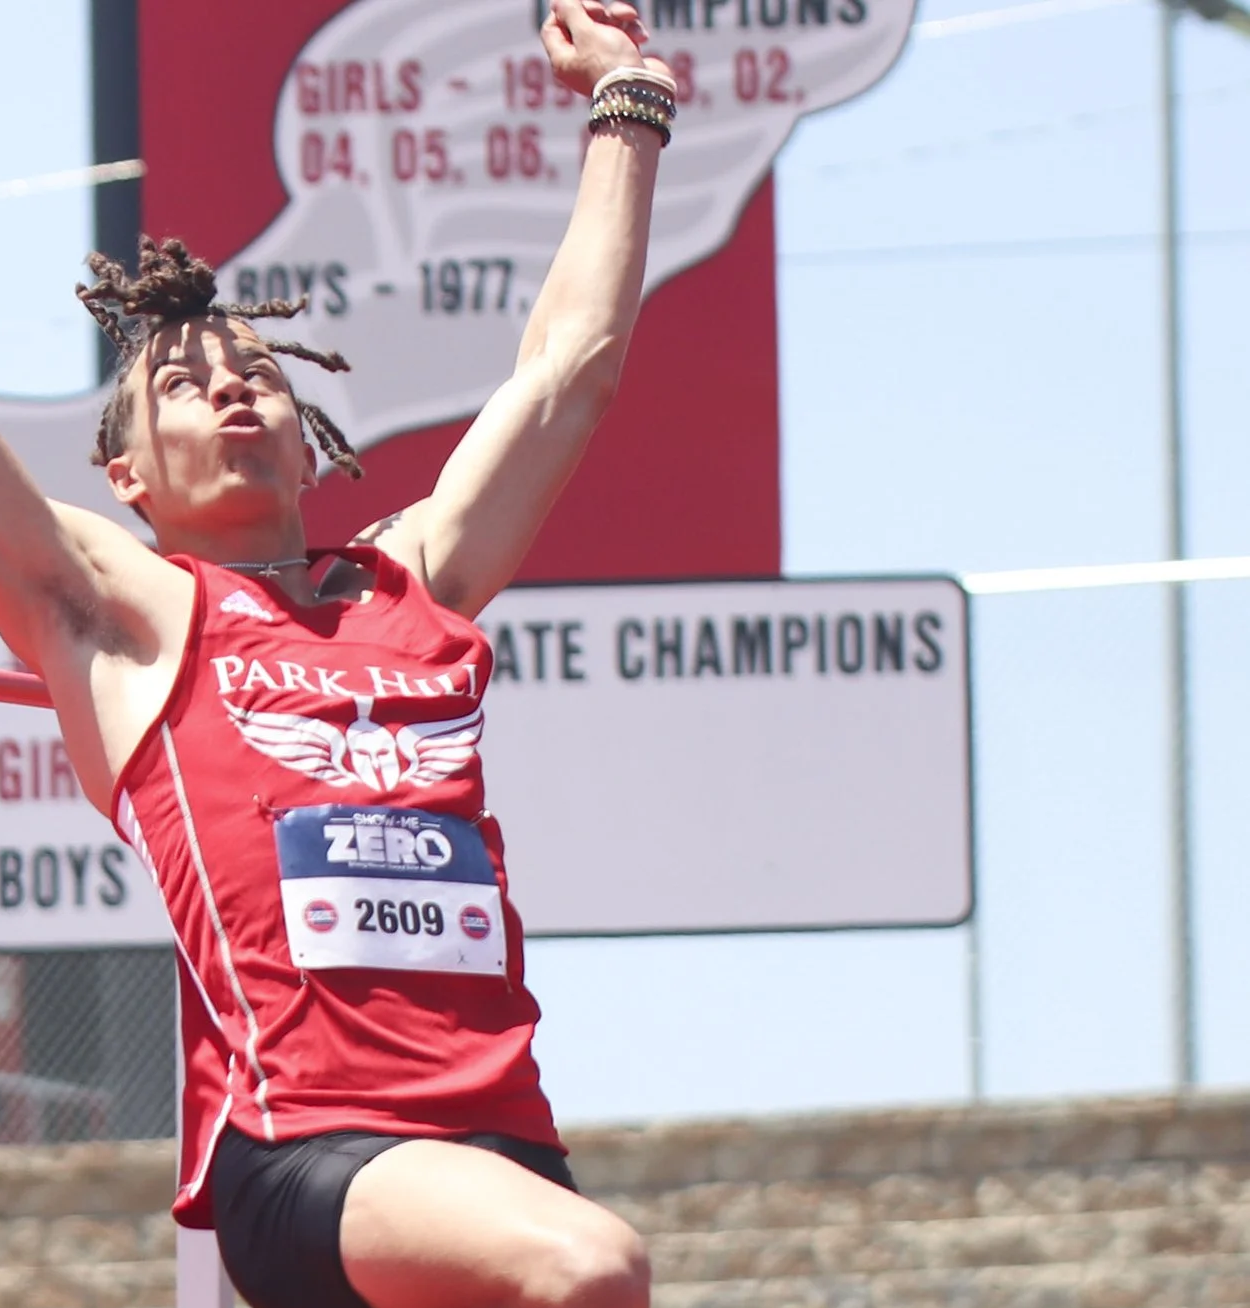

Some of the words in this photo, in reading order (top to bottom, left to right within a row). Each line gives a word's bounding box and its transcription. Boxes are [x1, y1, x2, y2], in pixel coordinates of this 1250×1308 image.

[296, 59, 423, 116] GIRLS
[236, 261, 348, 316] BOYS
[479, 618, 587, 682] ATE
[615, 610, 944, 681] CHAMPIONS
[209, 654, 358, 698] PARK
[323, 824, 453, 867] ZERO
[354, 897, 445, 937] 2609
